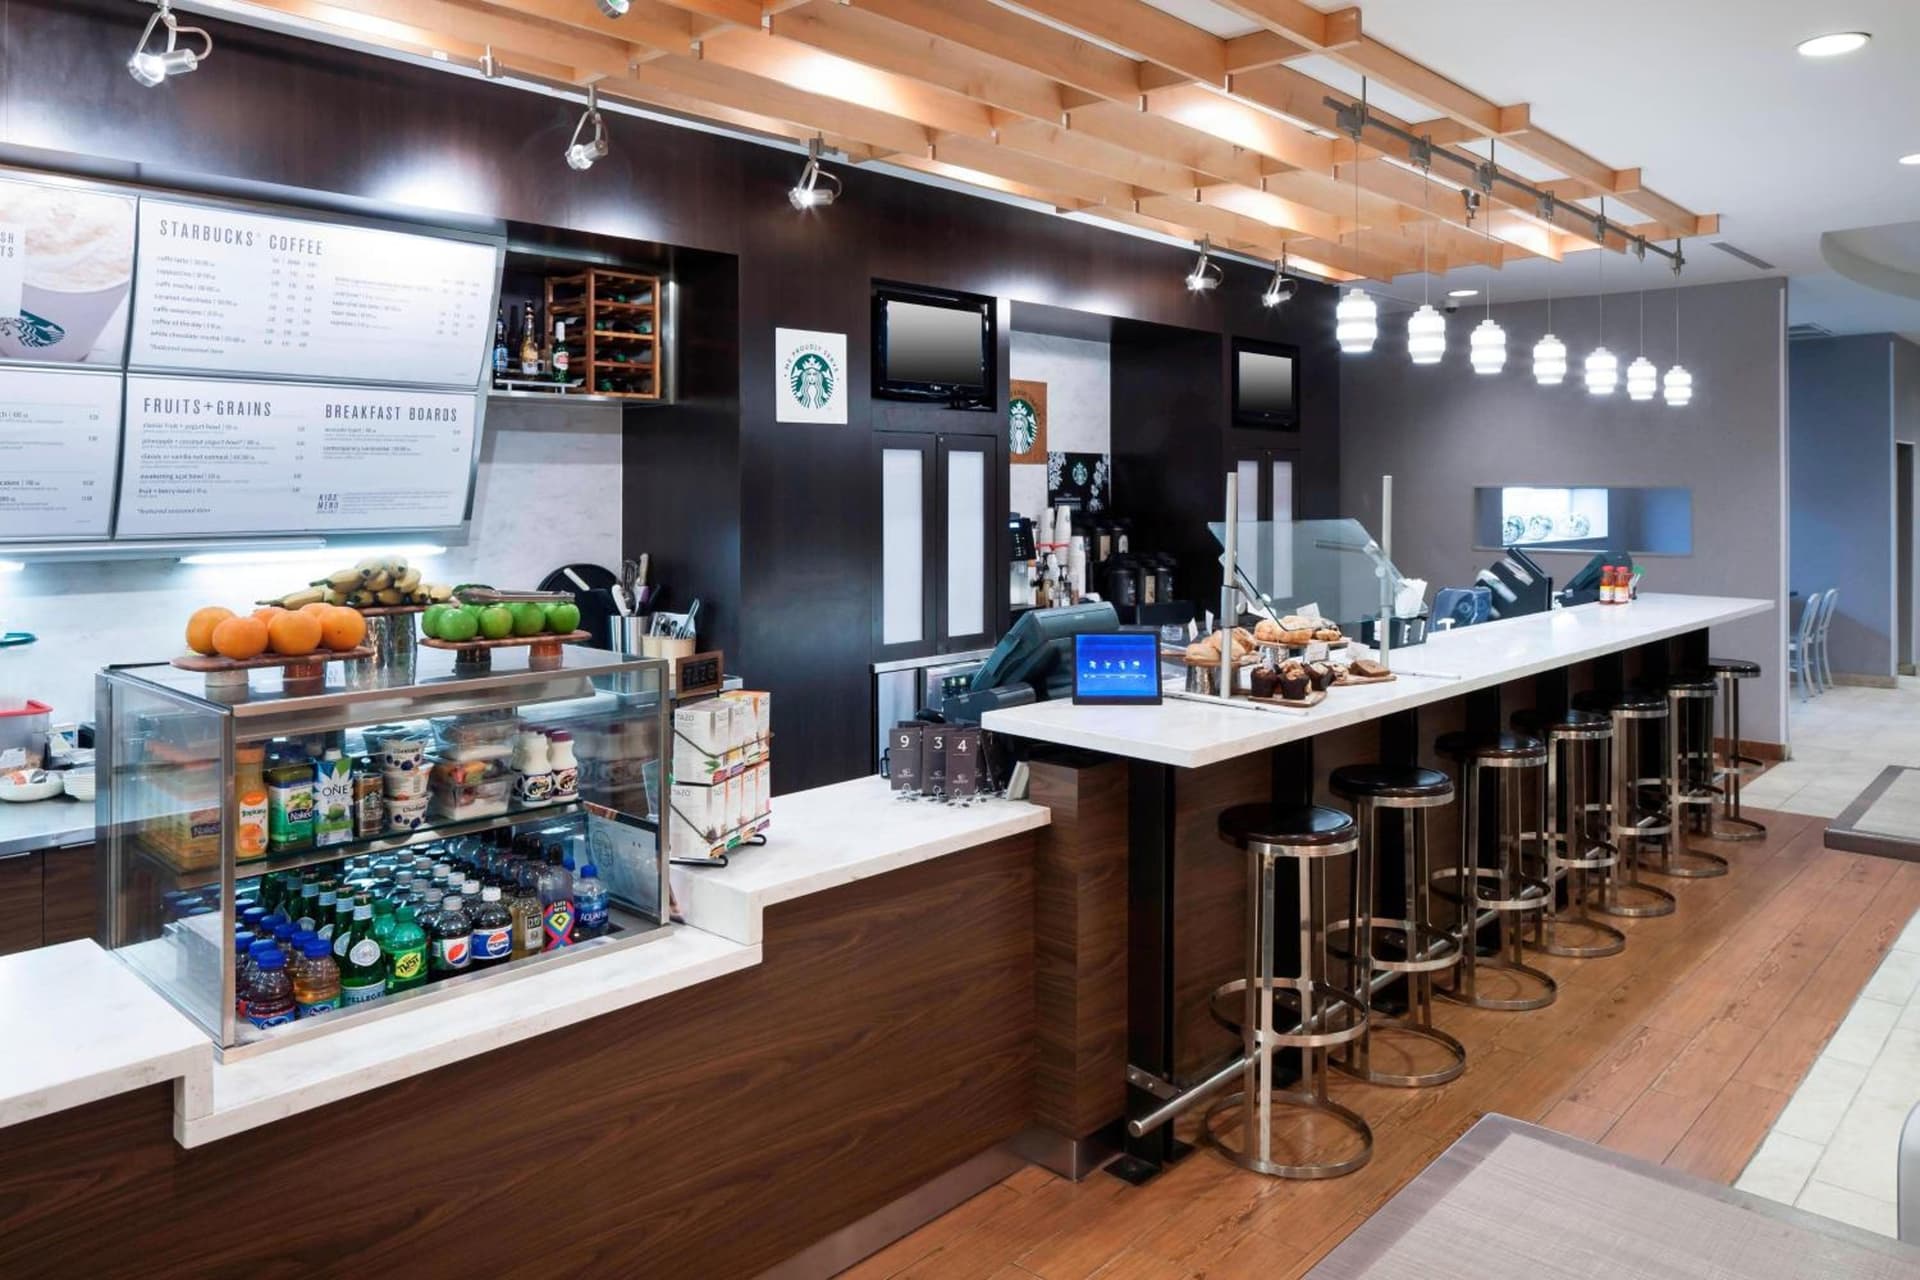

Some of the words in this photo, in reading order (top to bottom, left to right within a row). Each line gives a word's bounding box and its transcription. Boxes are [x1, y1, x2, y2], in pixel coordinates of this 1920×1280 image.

[159, 219, 254, 247] STARBUCKS
[269, 234, 323, 256] COFFEE
[325, 403, 401, 421] BREAKFAST
[409, 407, 457, 422] BOARDS
[900, 735, 910, 747] 9
[934, 736, 943, 749] 3
[957, 739, 967, 752] 4
